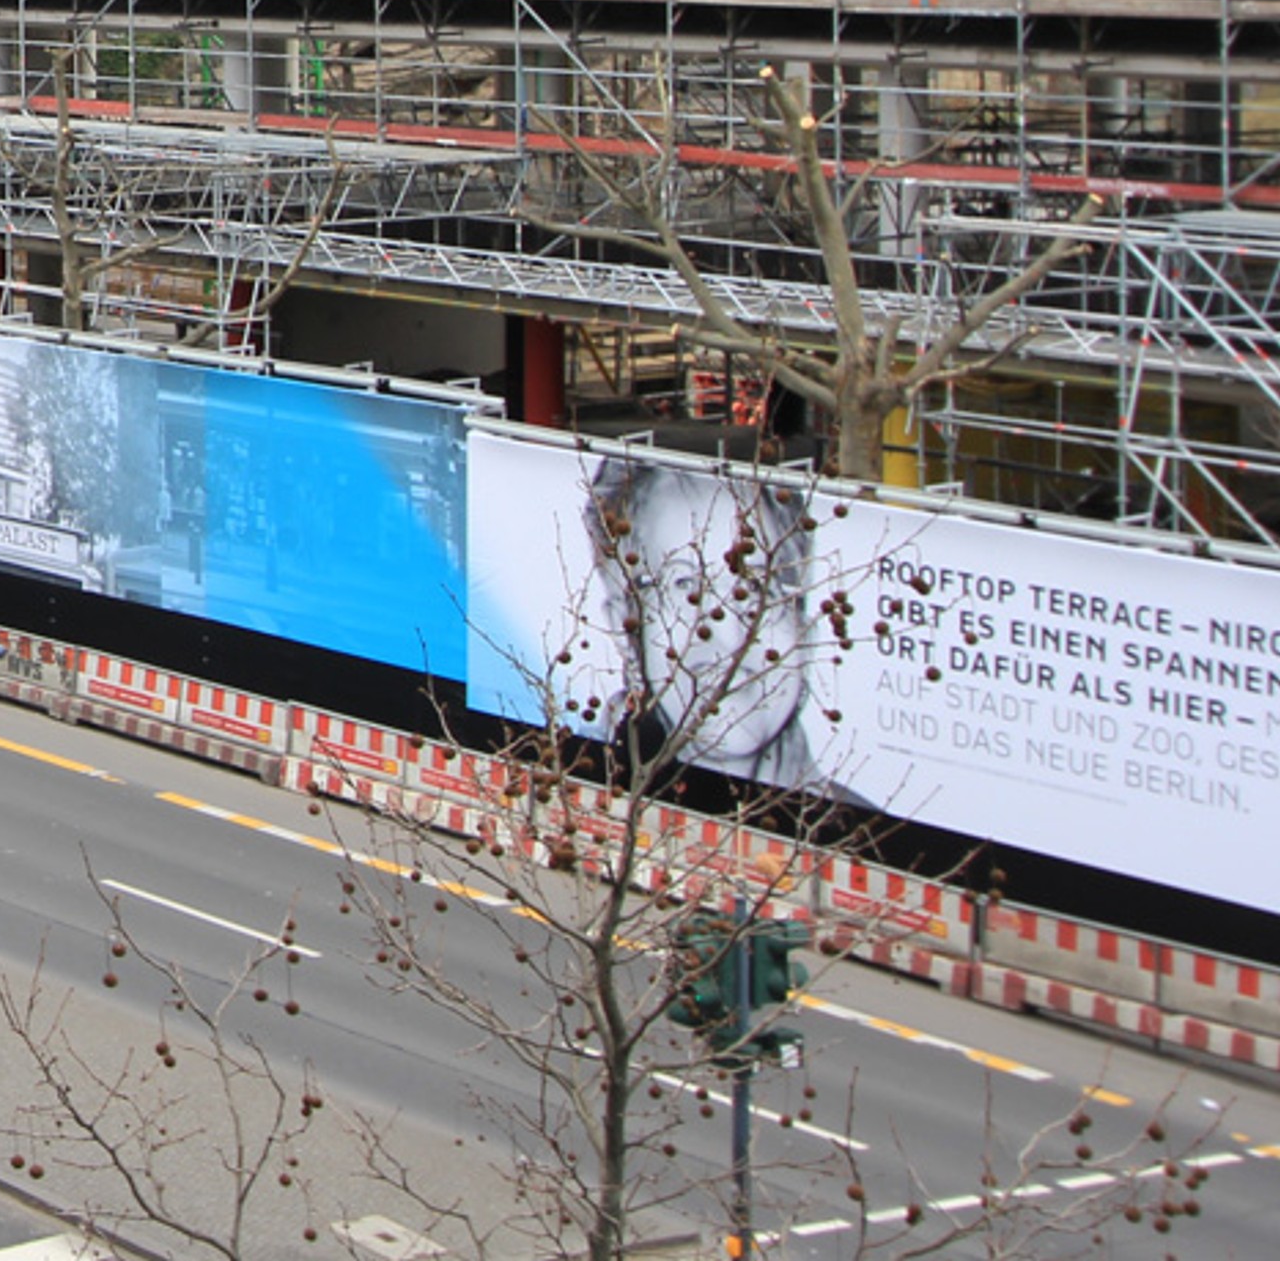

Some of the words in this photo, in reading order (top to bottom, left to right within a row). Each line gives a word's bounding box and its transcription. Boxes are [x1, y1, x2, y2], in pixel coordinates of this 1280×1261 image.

[878, 557, 1016, 604] ROOFTOP
[1030, 585, 1172, 635] TERRACE
[959, 611, 995, 640] ES
[1010, 619, 1107, 662] EINEN
[876, 669, 931, 701] AUF
[946, 682, 1038, 724] STADT
[1052, 710, 1118, 744] UND
[1132, 722, 1203, 767] ZOO,
[877, 630, 935, 664] ORT
[950, 646, 1056, 691] DAFÜR
[1070, 672, 1133, 706] ALS
[1149, 686, 1227, 727] HIER
[877, 705, 939, 742] UND
[954, 721, 1012, 759] DAS
[1026, 740, 1108, 781] NEUE
[1125, 760, 1251, 815] BERLIN.
